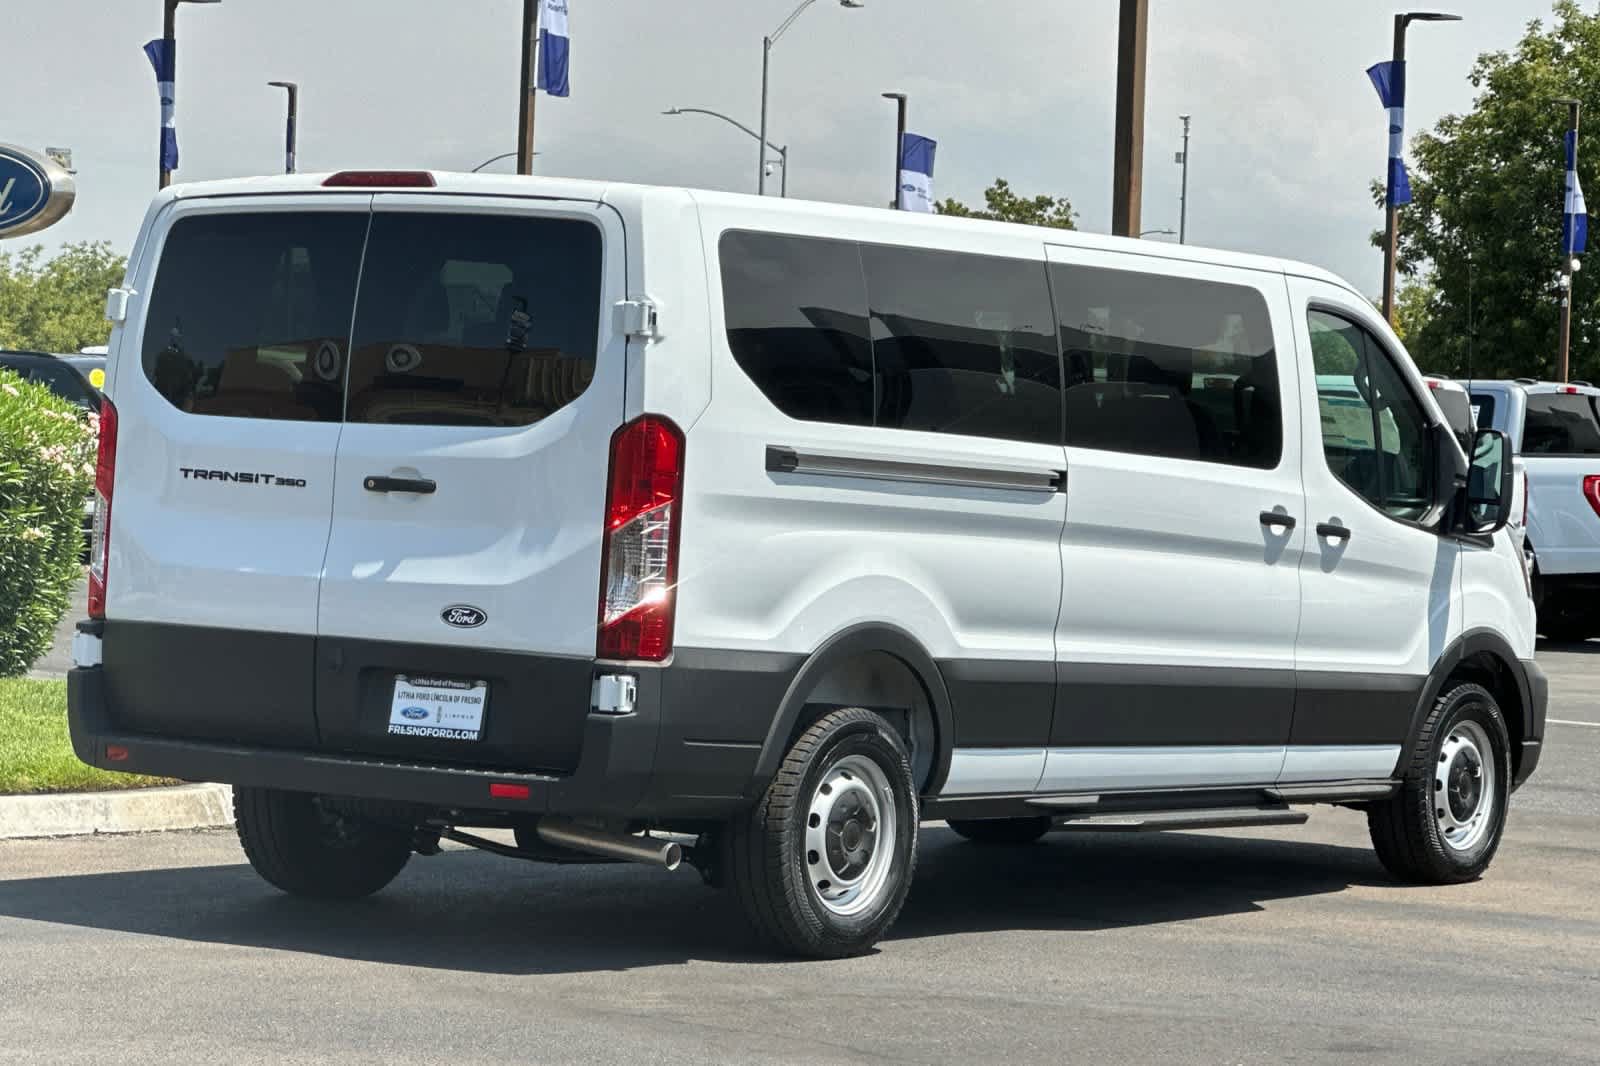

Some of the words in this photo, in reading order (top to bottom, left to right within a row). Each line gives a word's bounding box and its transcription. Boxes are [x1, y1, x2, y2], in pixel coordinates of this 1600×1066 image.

[448, 608, 477, 624] Ford
[398, 691, 415, 699] LITHIA
[416, 692, 430, 701] FORD
[431, 693, 453, 702] LINCOLN
[453, 695, 460, 703] OF
[461, 696, 482, 705] FRESNO
[388, 725, 478, 740] FRESNOFORD.COM
